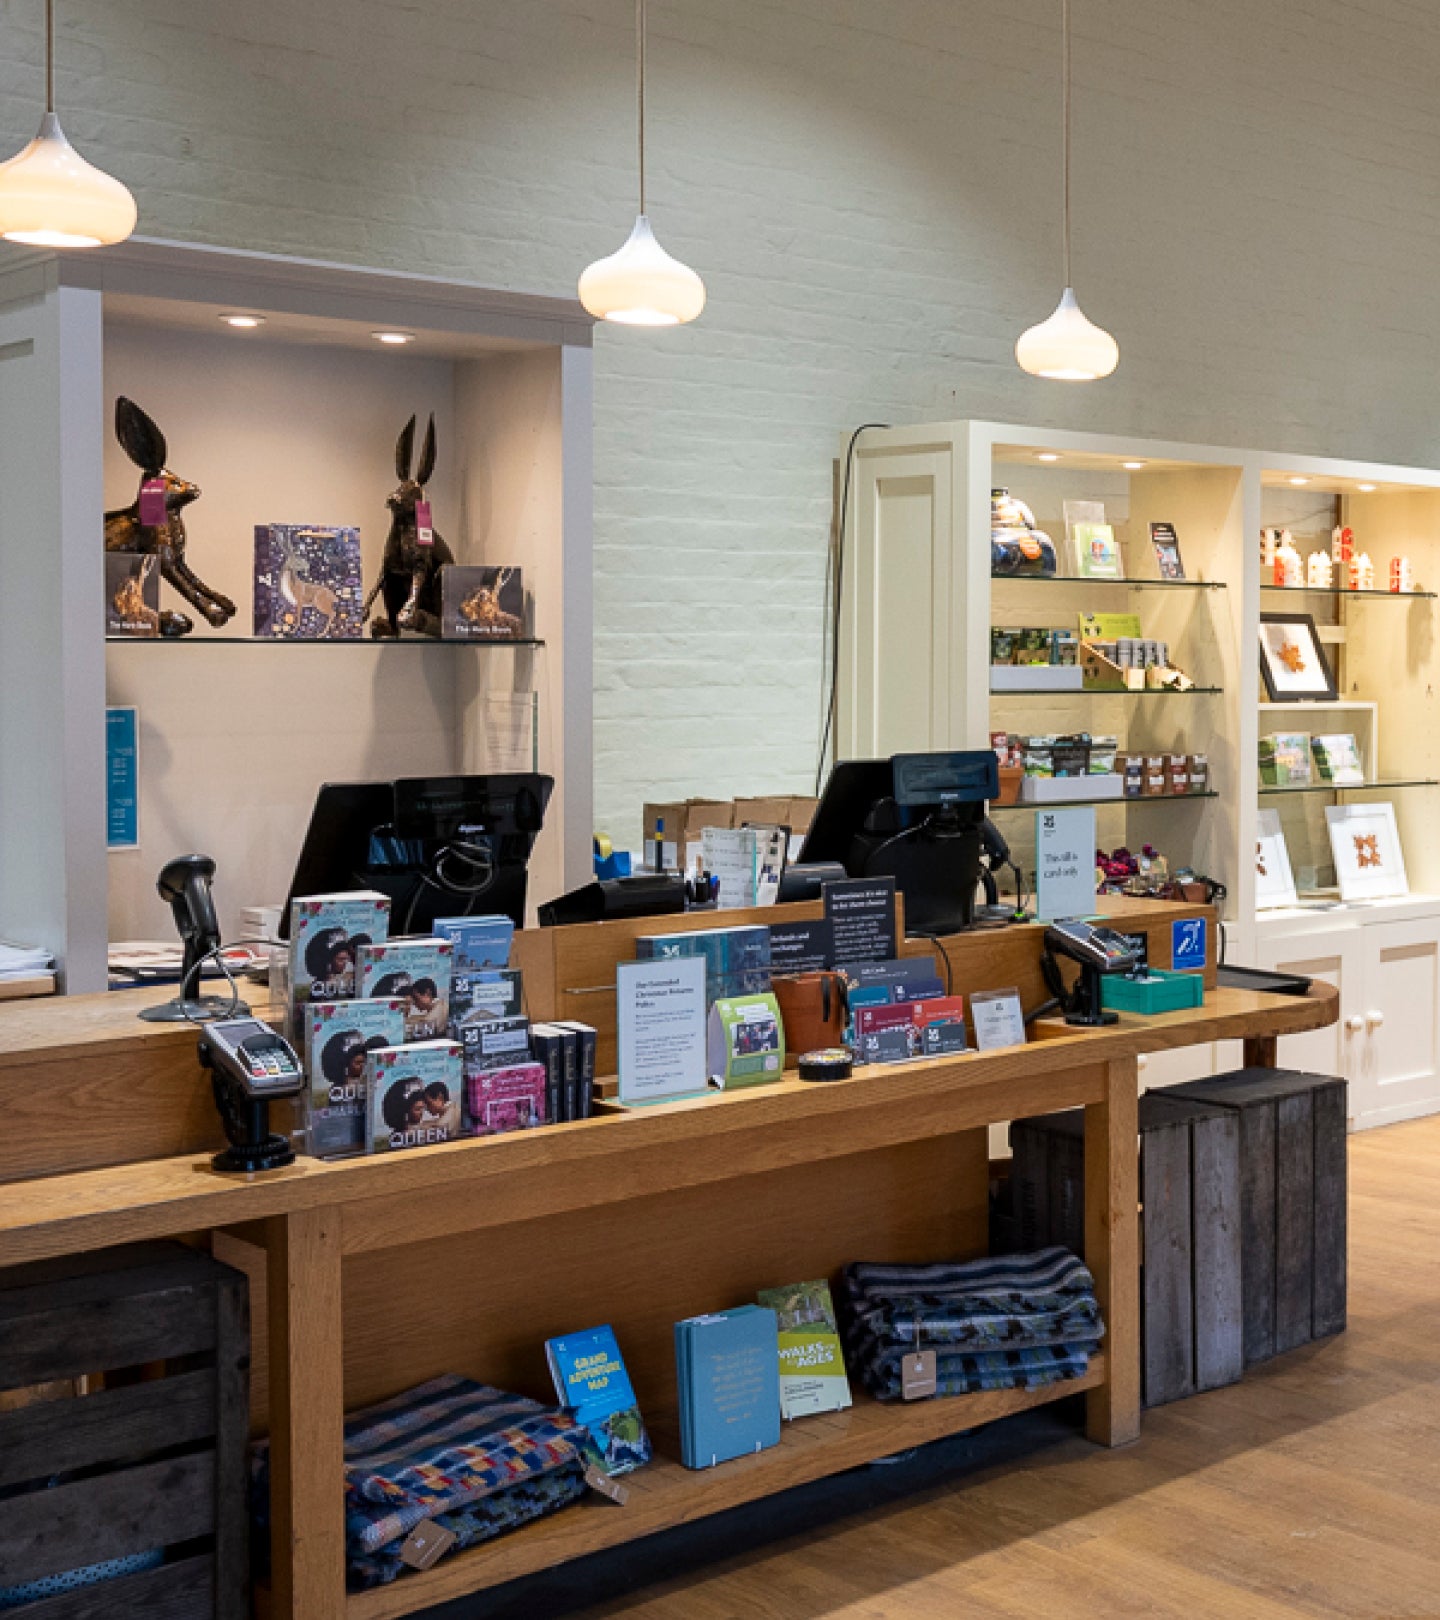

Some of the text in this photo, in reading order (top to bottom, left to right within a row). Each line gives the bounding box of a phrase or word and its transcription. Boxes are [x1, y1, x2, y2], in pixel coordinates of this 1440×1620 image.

[455, 625, 469, 633] The
[389, 1126, 448, 1149] QUEEN
[777, 1342, 824, 1359] WALKS
[587, 1376, 609, 1391] MAP
